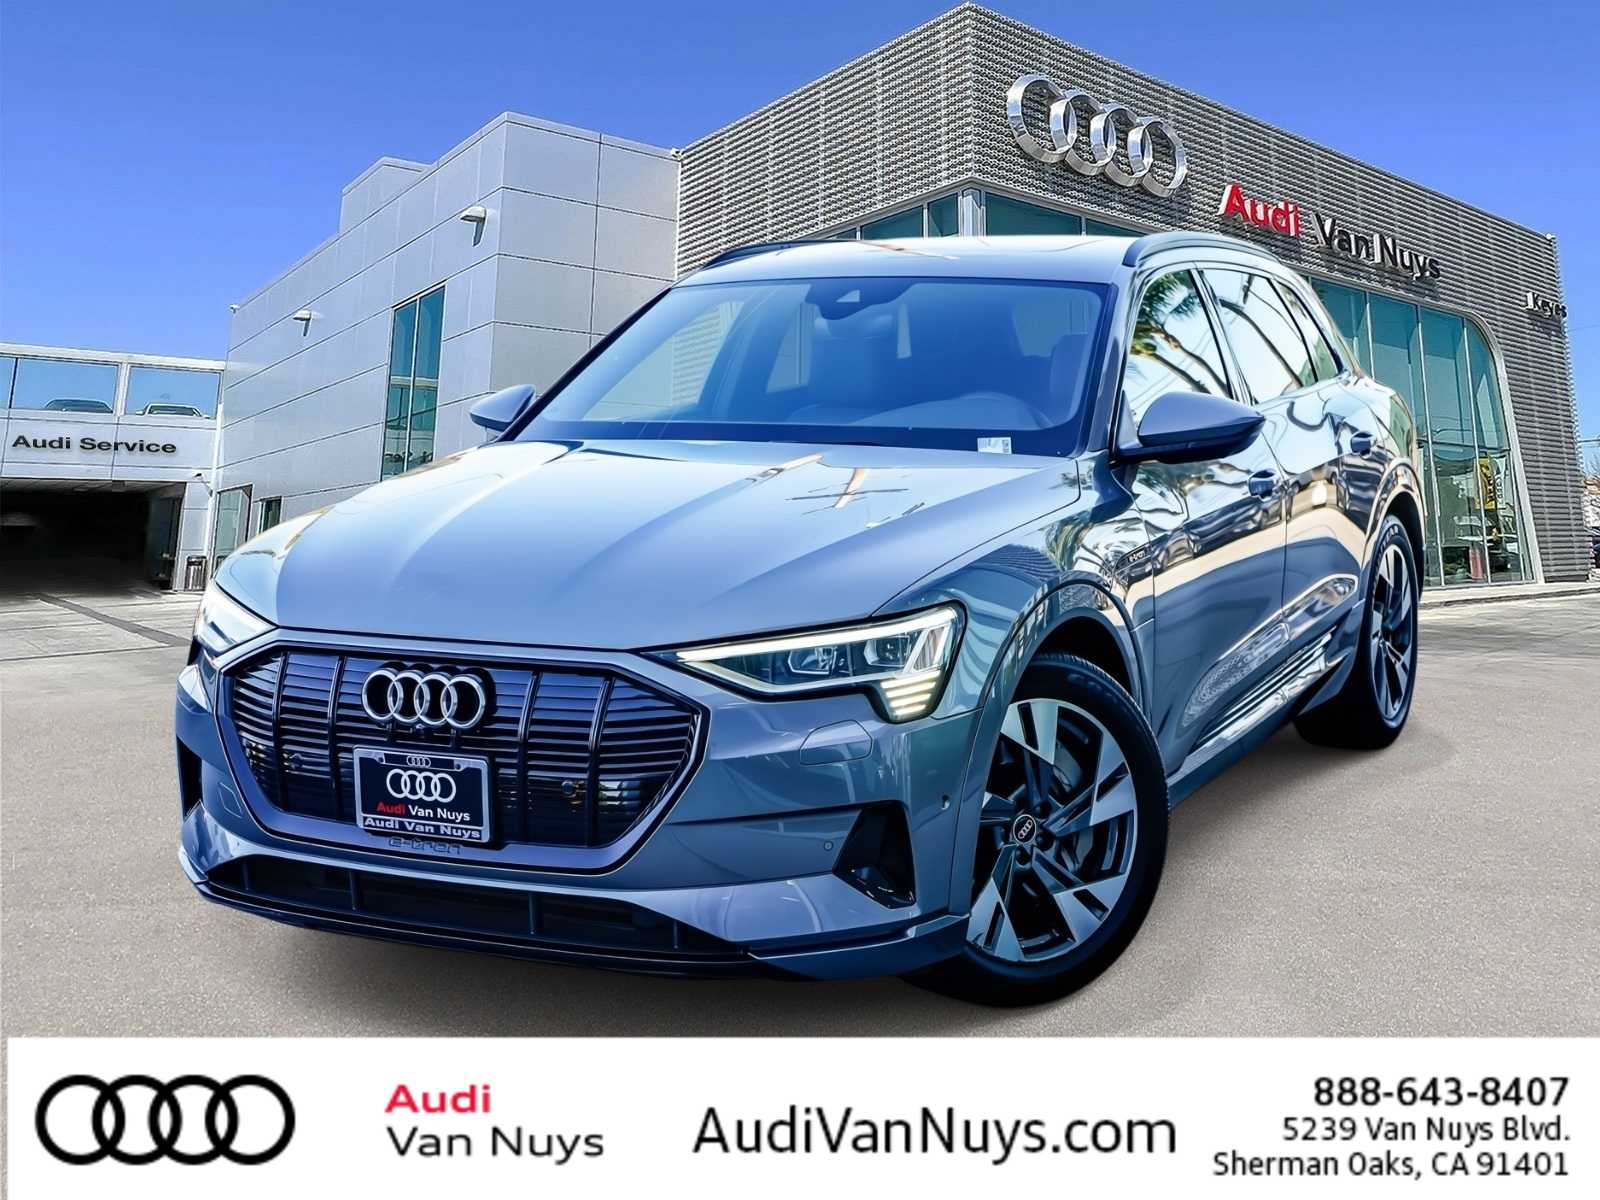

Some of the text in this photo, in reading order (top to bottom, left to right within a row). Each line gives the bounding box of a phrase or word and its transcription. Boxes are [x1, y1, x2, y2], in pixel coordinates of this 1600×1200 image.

[1218, 182, 1441, 281] Audi Van Nuys
[12, 434, 177, 454] Audi Service
[376, 802, 471, 823] Audi Van Nuys
[364, 817, 481, 839] Audi Van Nuys
